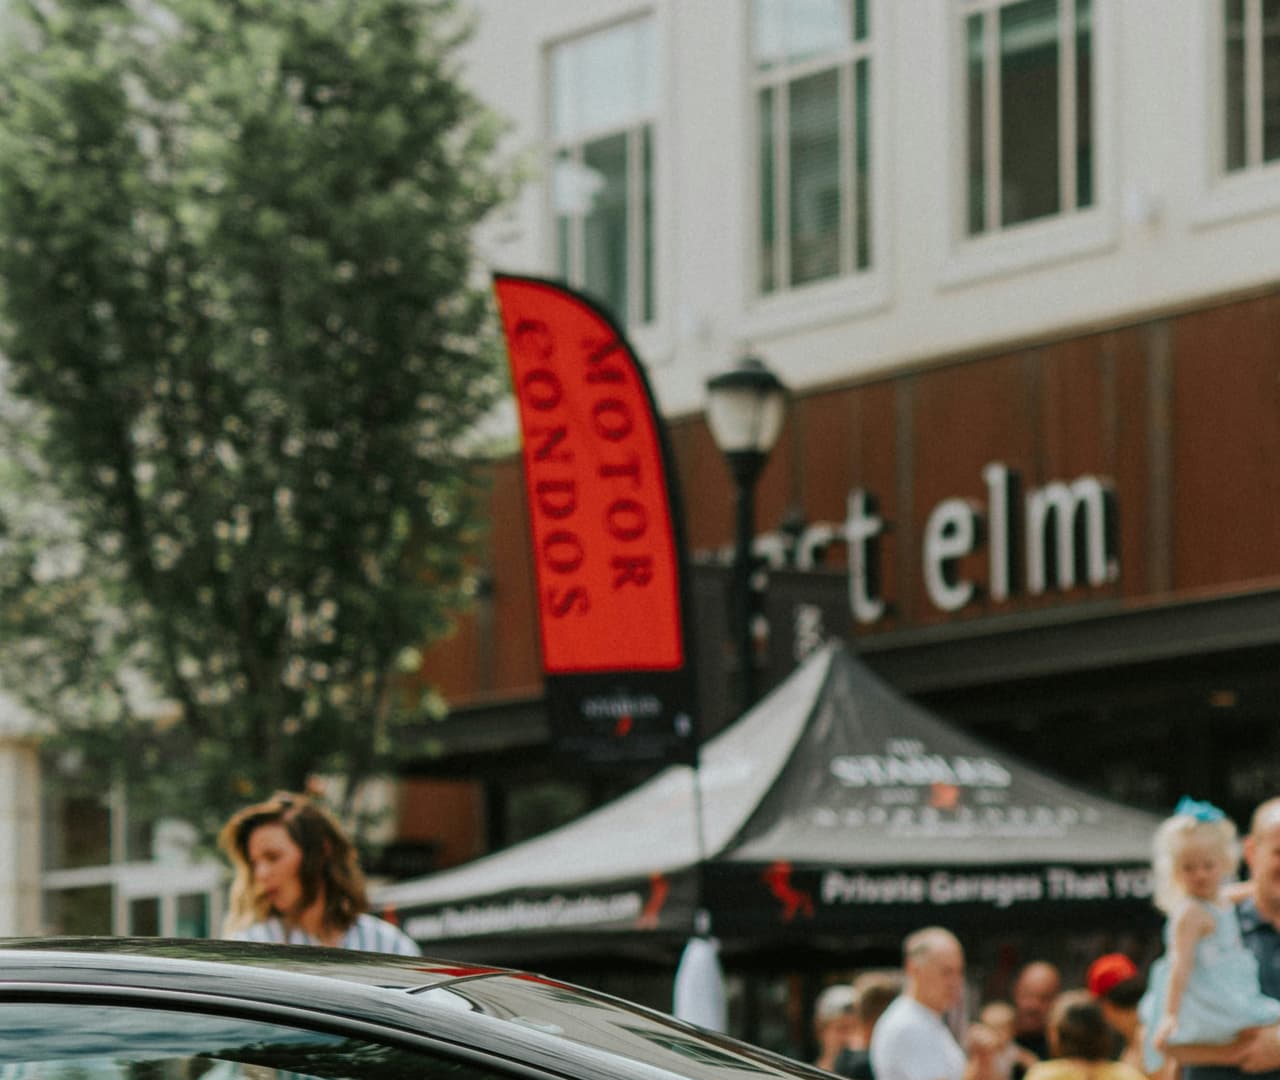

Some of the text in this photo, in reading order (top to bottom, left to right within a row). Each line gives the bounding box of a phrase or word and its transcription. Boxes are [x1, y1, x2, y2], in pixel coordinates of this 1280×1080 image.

[514, 318, 592, 621] CONDOS
[580, 334, 656, 595] MOTOR
[922, 461, 1107, 612] elm
[823, 870, 924, 905] Private
[930, 872, 1042, 908] Garages
[1047, 867, 1110, 900] That
